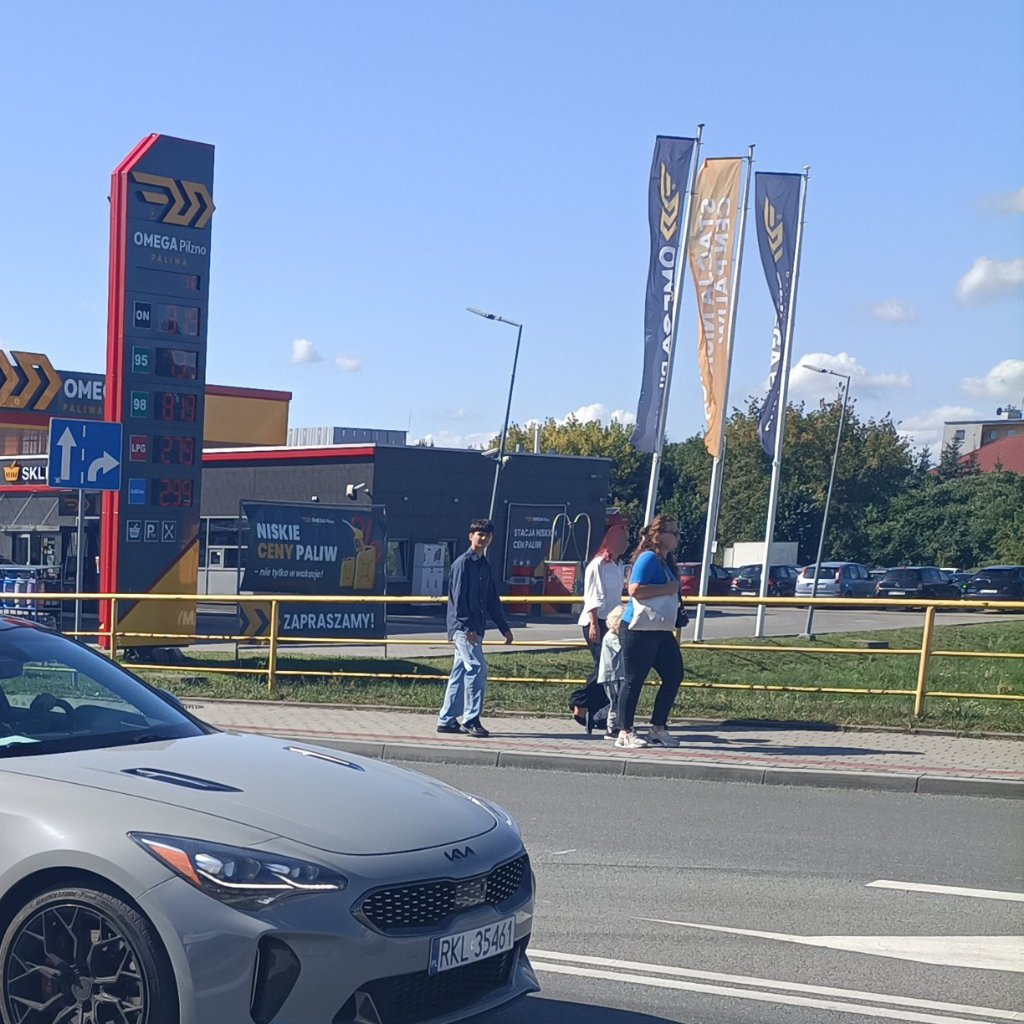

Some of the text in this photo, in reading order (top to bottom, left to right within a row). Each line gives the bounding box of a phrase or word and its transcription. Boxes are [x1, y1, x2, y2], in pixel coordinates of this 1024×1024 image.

[133, 231, 207, 256] OMEGA Pilzno
[150, 253, 188, 267] PALIWA
[135, 309, 150, 322] ON
[134, 353, 149, 367] 95
[63, 377, 106, 401] OME
[62, 403, 103, 416] PALIWA
[134, 397, 148, 411] 98
[130, 442, 147, 454] LPG
[255, 522, 301, 541] NISKIE
[512, 528, 536, 537] STACJA
[257, 541, 338, 562] CENY PALIW
[512, 540, 525, 549] CEN
[259, 567, 271, 577] nie
[271, 567, 289, 579] tylko
[283, 612, 375, 630] ZAPRASZAMY!
[439, 920, 513, 968] RKL 35461
